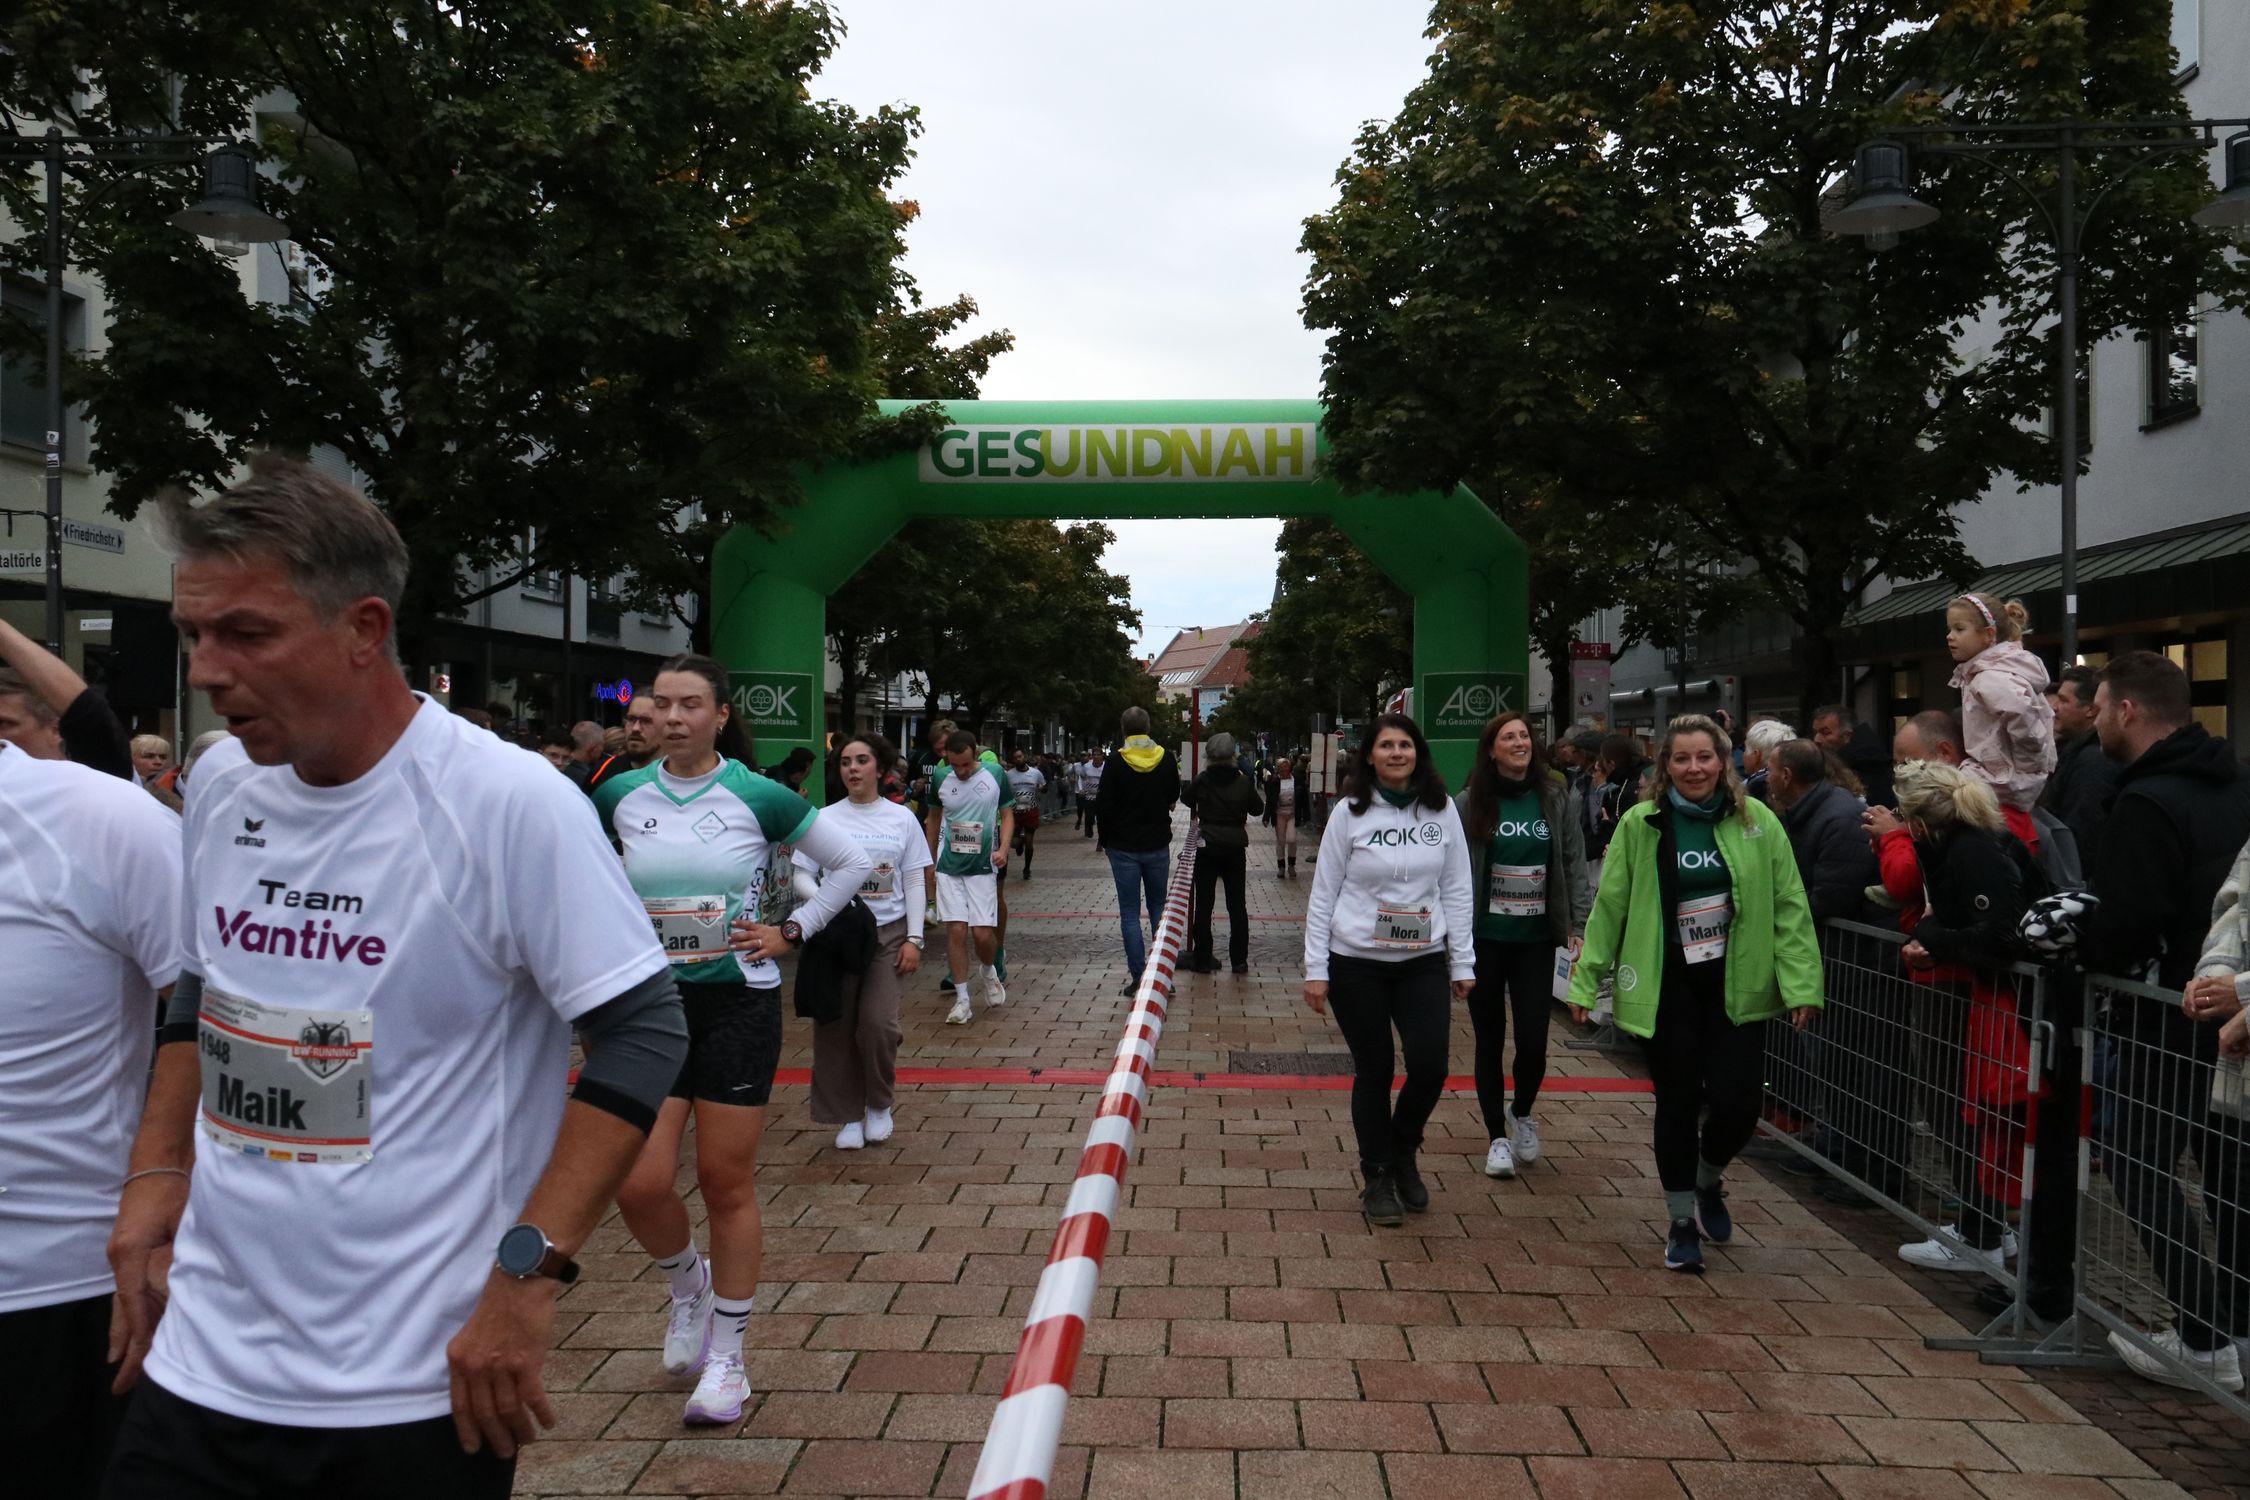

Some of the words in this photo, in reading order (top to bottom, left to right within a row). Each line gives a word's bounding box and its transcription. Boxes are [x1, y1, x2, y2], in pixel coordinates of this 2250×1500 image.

[931, 427, 1304, 477] GESUNDNAH
[69, 524, 117, 547] Friedrichstr.
[596, 682, 617, 702] Apollo
[731, 684, 798, 717] AOK
[1438, 684, 1513, 717] AOK
[1435, 718, 1447, 726] Die
[234, 834, 266, 848] erima
[955, 833, 976, 843] Robin
[1366, 826, 1419, 847] AOK
[1677, 850, 1722, 869] OK
[258, 878, 363, 914] Team
[859, 880, 879, 893] aty
[1491, 887, 1543, 900] Alessandra
[1378, 914, 1393, 923] 244
[1680, 917, 1696, 926] 279
[215, 905, 386, 966] Vantive
[1390, 926, 1419, 940] Nora
[200, 1031, 231, 1065] 1948
[294, 1045, 357, 1058] BW-RUNNING
[218, 1073, 307, 1131] Maik
